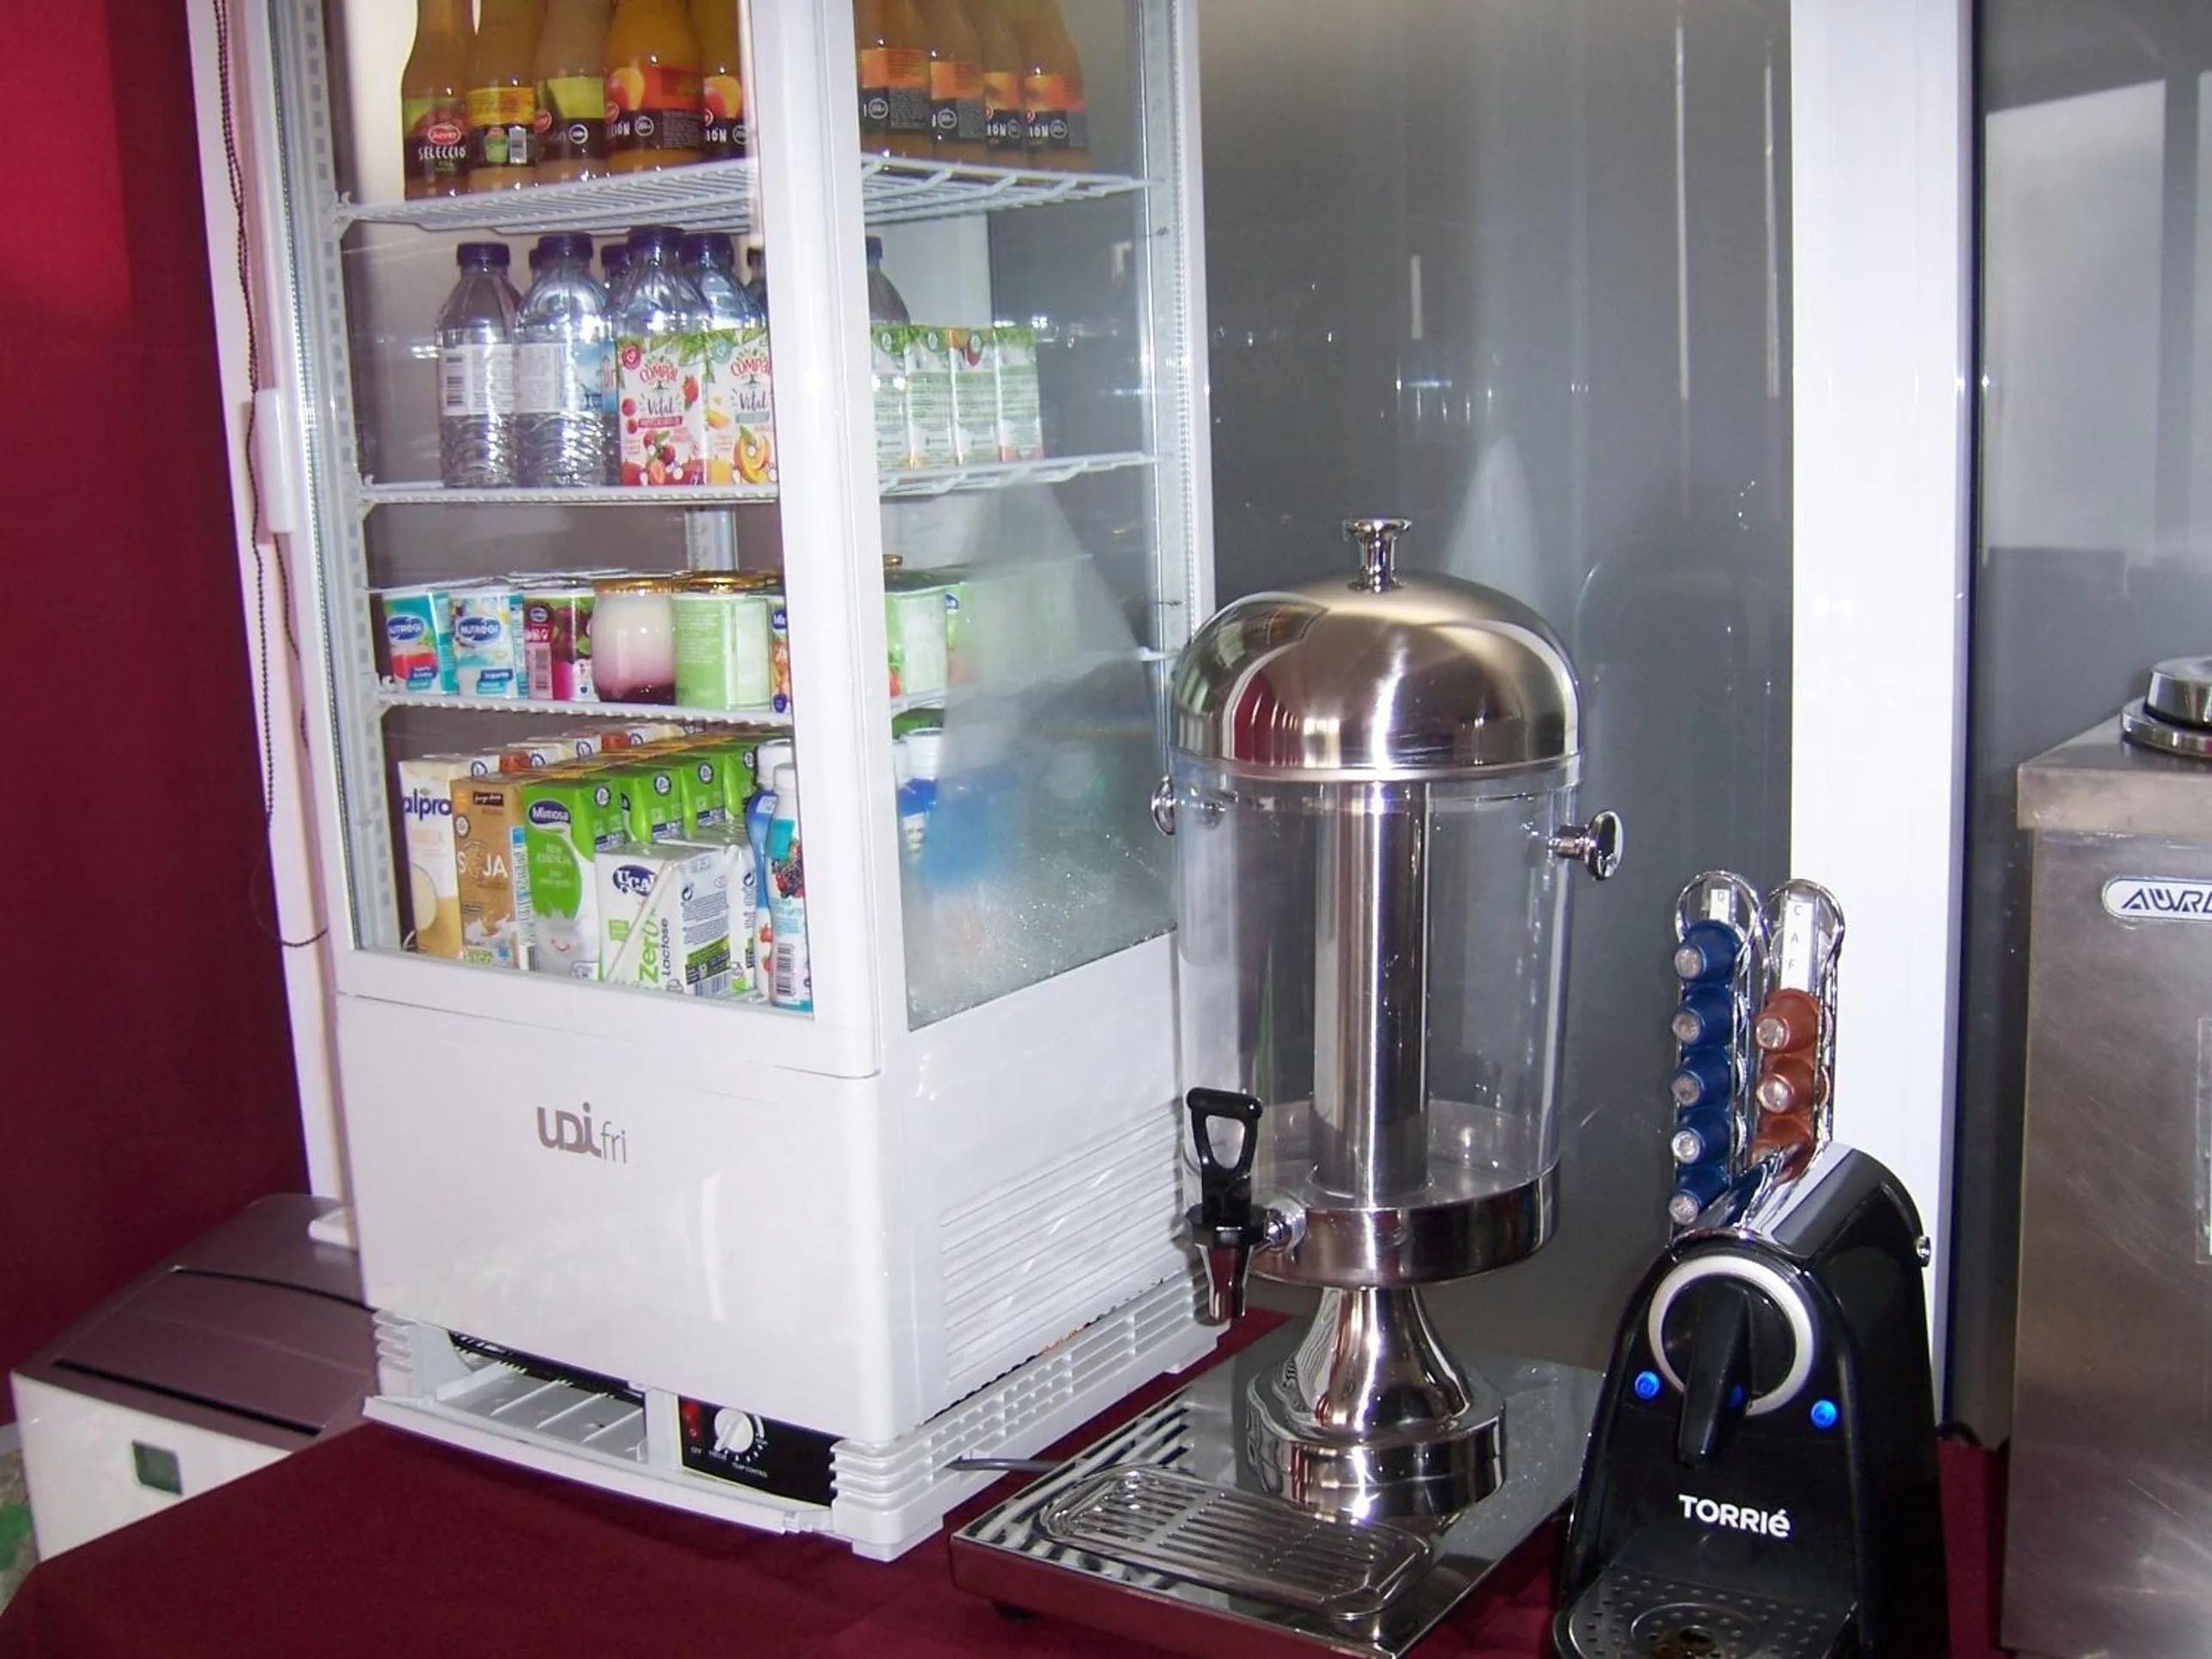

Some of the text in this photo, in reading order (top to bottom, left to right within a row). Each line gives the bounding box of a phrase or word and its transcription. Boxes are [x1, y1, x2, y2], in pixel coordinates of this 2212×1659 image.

[647, 394, 675, 416] Vital
[739, 389, 767, 413] Vital
[403, 787, 453, 821] alpro
[532, 805, 569, 822] Mimosa
